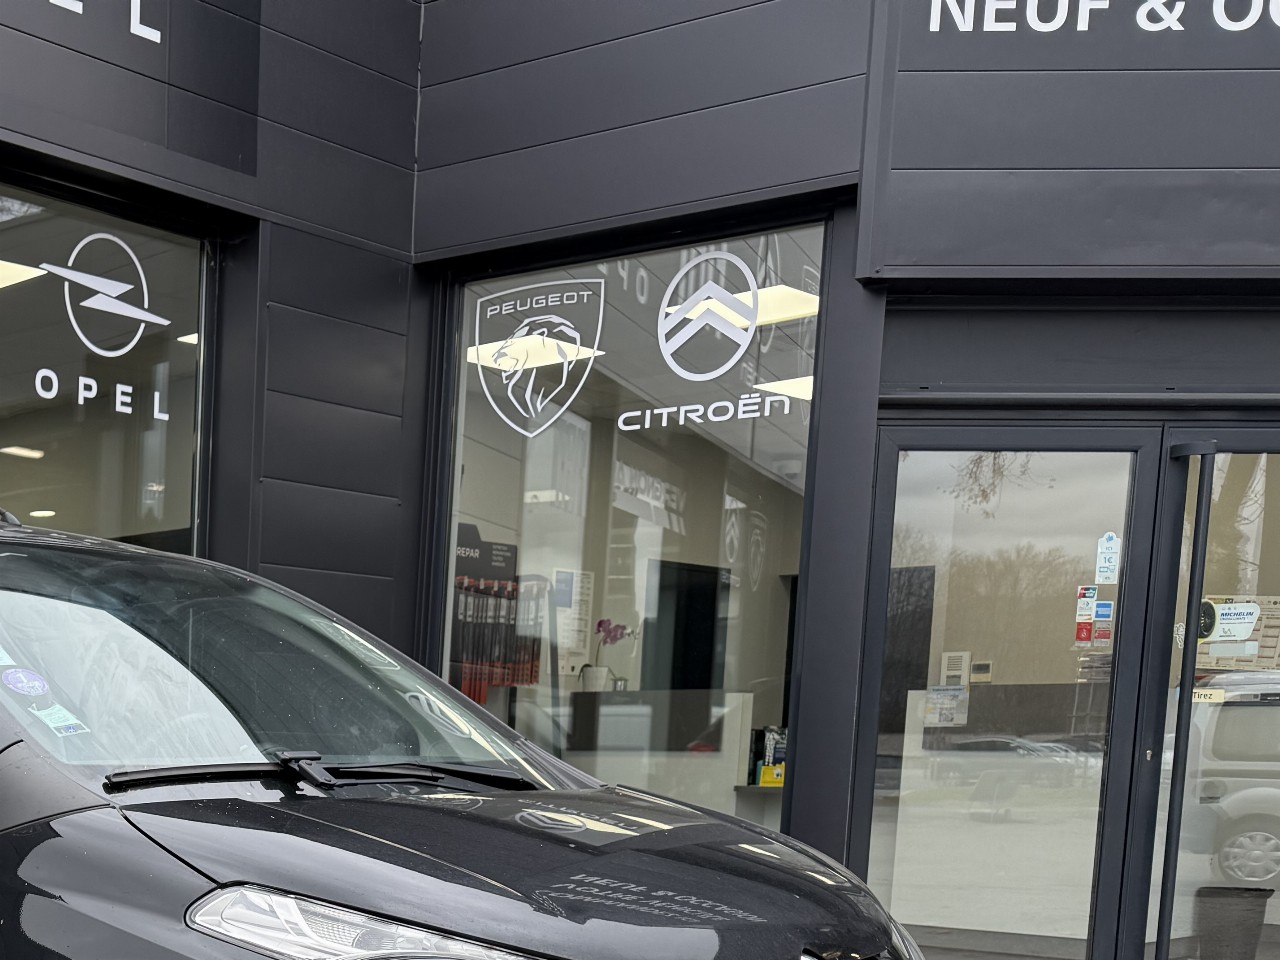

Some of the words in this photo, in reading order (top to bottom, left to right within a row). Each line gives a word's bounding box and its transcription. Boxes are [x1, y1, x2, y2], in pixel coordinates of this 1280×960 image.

[929, 0, 1110, 32] NEUF
[1136, 0, 1185, 31] &
[1213, 0, 1280, 31] O
[486, 291, 593, 319] PEUGEOT
[35, 367, 170, 422] OPEL
[1193, 691, 1213, 700] Tirez
